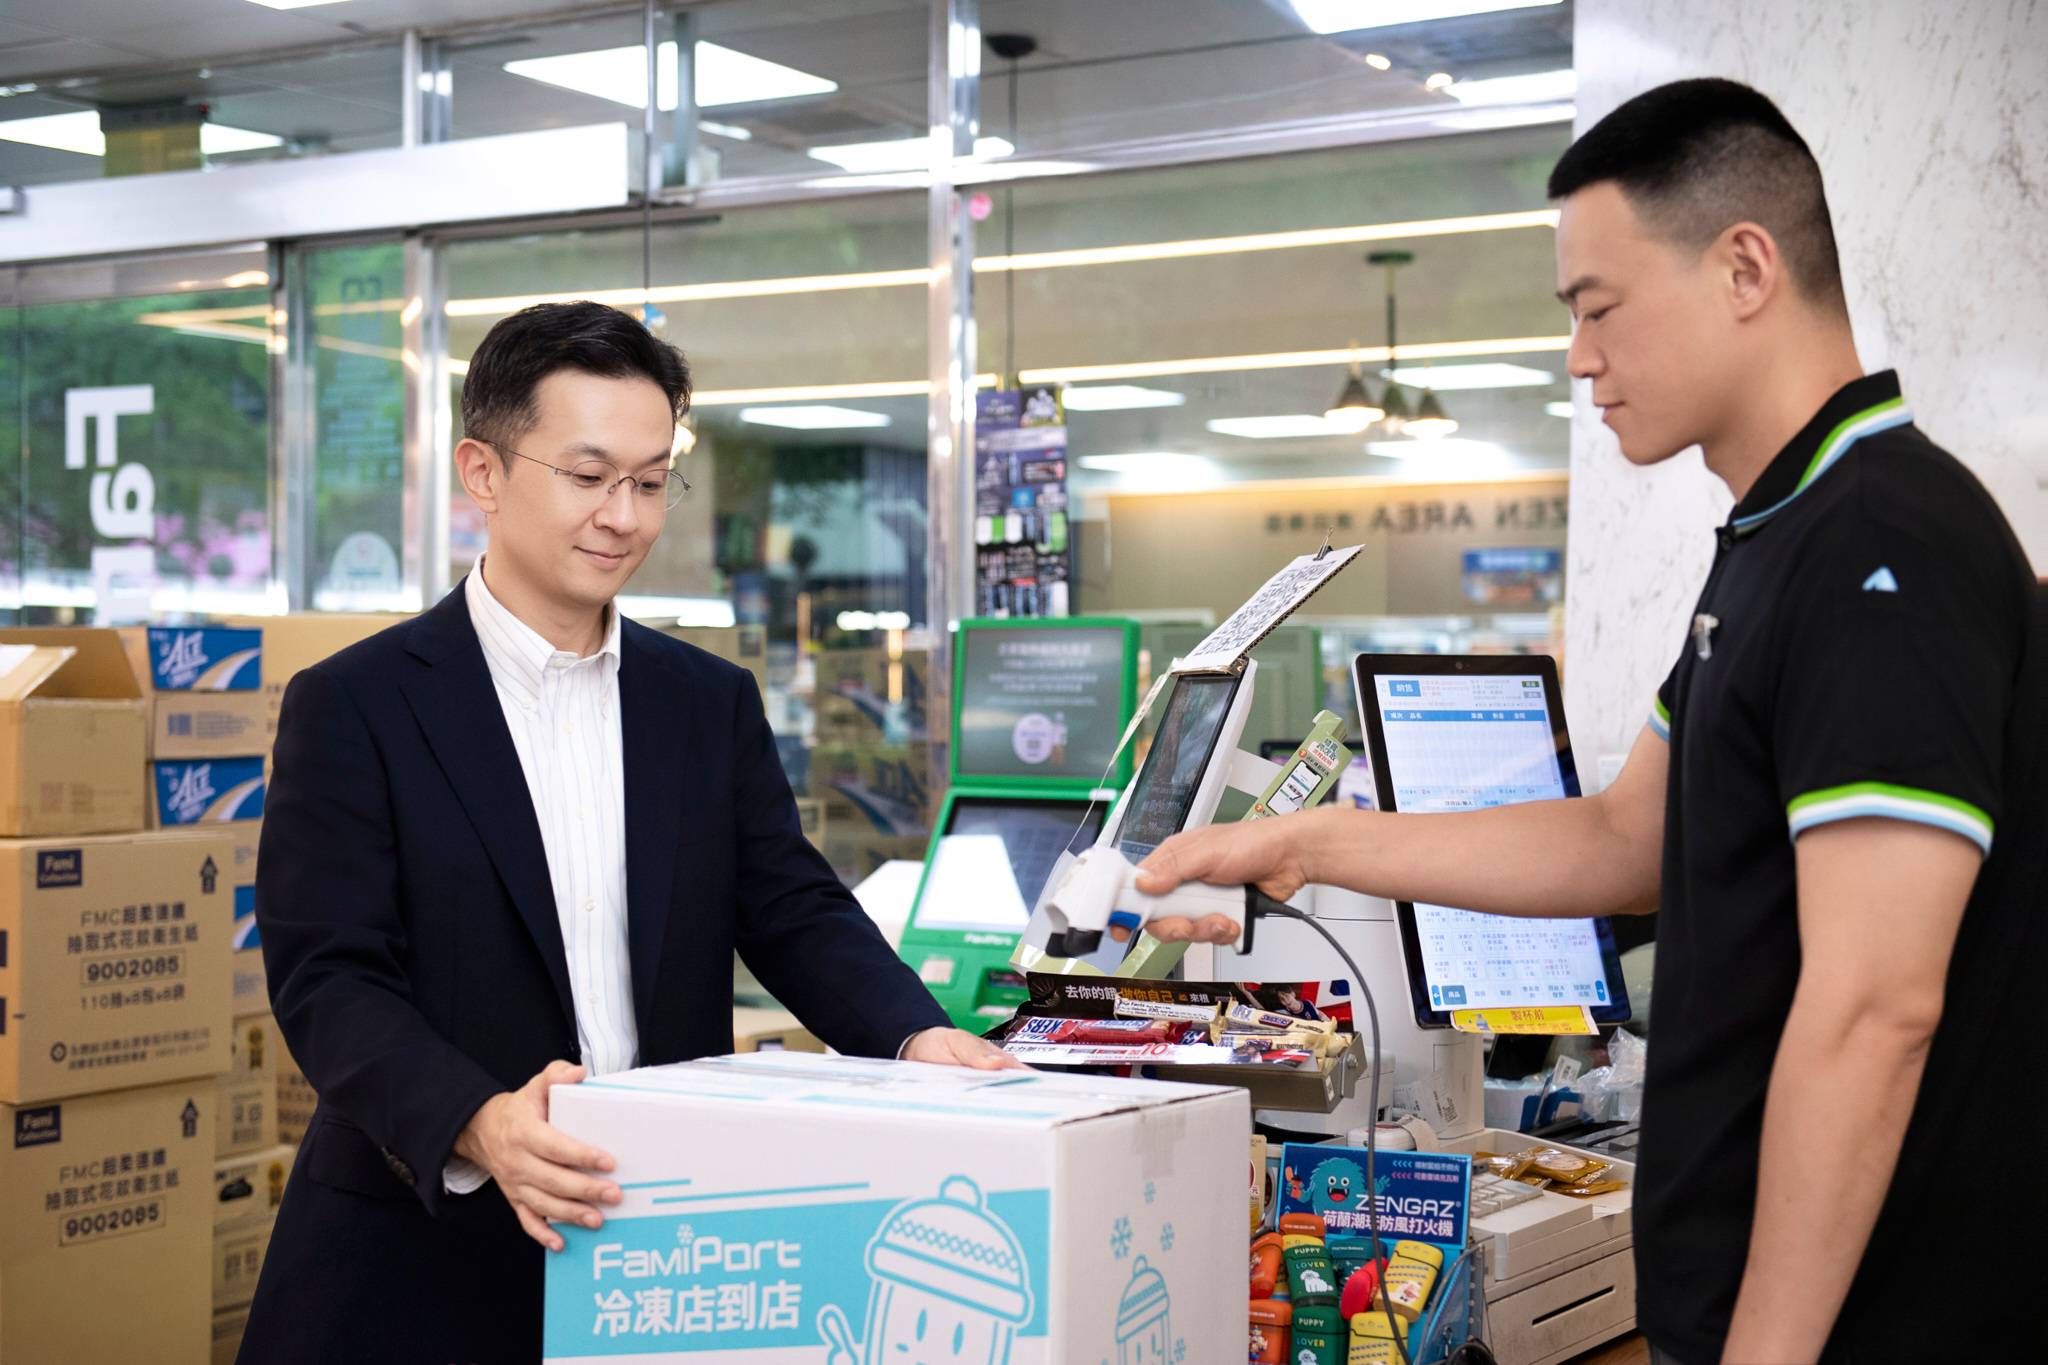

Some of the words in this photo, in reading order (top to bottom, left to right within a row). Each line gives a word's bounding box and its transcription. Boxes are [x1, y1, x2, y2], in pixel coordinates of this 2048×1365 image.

[87, 955, 179, 982] 9002085
[66, 1202, 160, 1238] 9002085
[593, 1235, 801, 1281] FamiPort
[1294, 1247, 1321, 1255] PUPPY
[1295, 1260, 1325, 1269] LOVER
[592, 1279, 802, 1338] 冷凍店到店
[1298, 1317, 1325, 1328] PUPPY
[1296, 1337, 1326, 1348] LOVER
